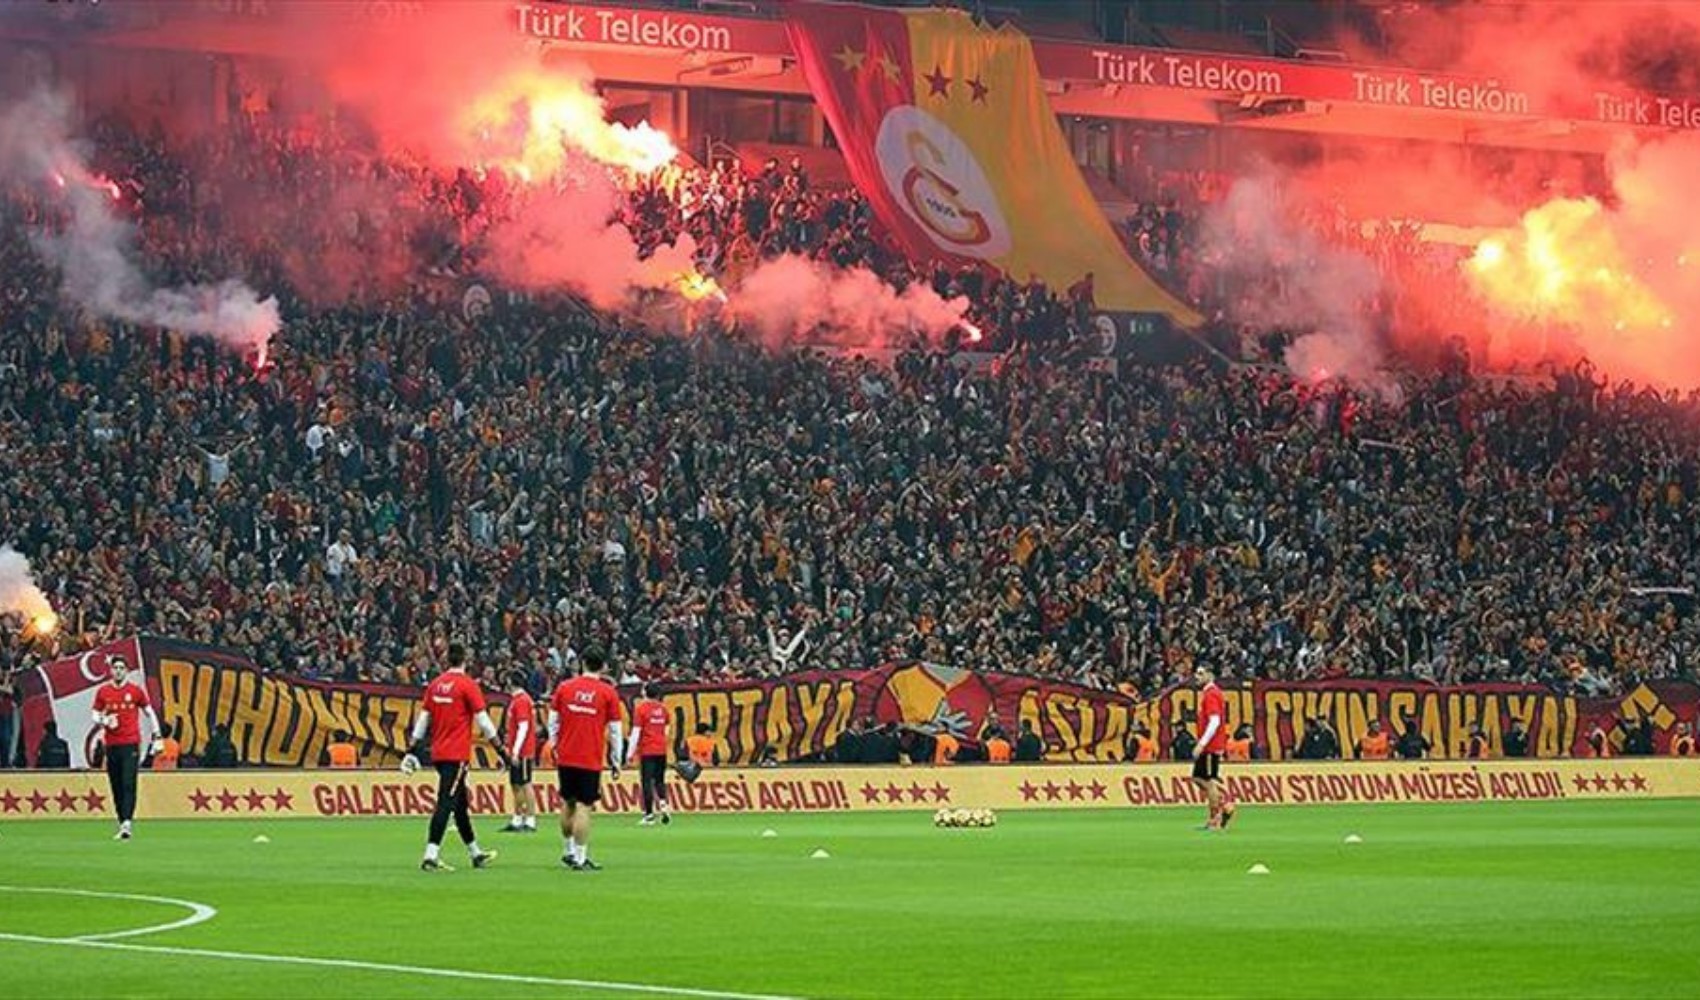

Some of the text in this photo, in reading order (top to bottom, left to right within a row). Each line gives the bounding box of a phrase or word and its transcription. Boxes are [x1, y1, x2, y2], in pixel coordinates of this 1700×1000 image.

[515, 5, 731, 50] Türk Telekom
[1092, 51, 1282, 93] Türk Telekom
[1352, 73, 1528, 113] Türk Telekom
[1594, 93, 1700, 129] Türk Tele
[313, 783, 505, 815] GALATASRAY
[758, 780, 850, 812] AÇILDI!
[1287, 773, 1399, 802] STADYUM
[1399, 766, 1488, 800] MÜZESİ
[1489, 771, 1566, 799] AÇILDI!
